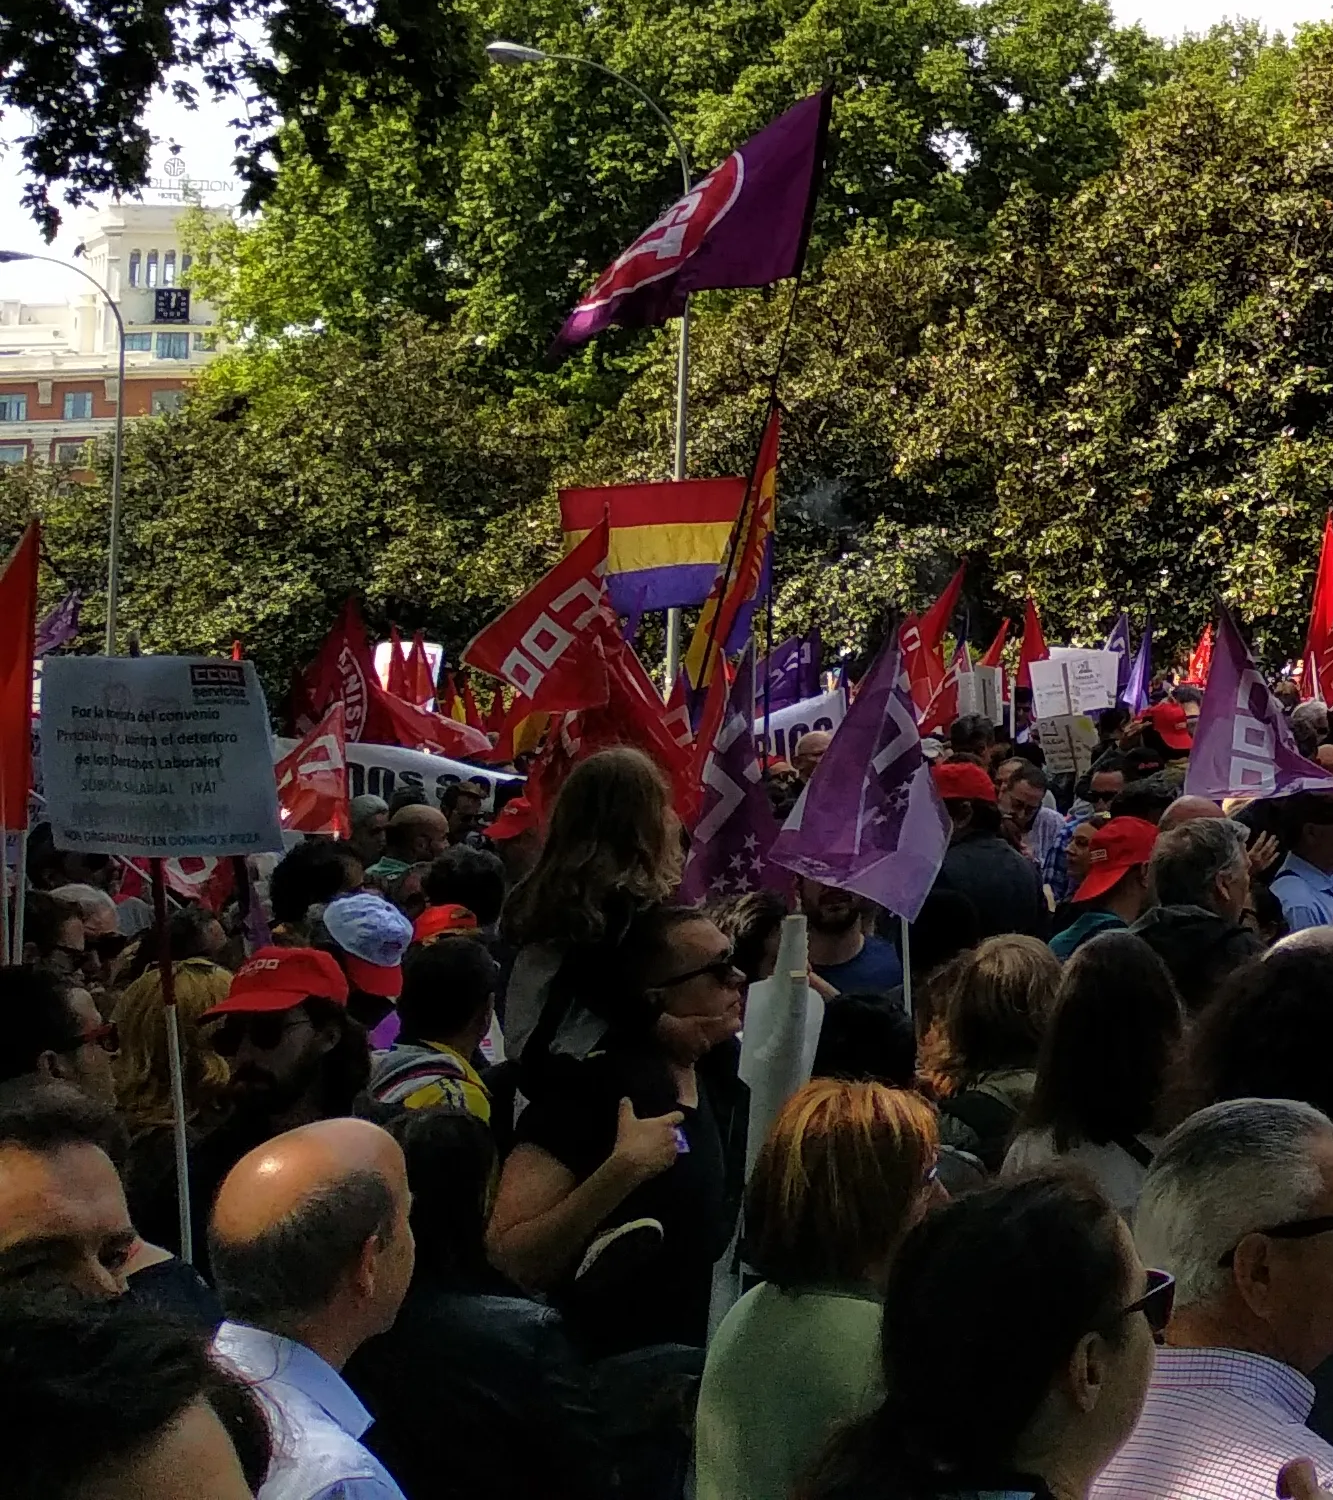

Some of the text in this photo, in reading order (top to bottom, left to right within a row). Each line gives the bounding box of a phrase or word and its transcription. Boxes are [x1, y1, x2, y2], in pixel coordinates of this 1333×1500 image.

[72, 705, 91, 718] Por
[137, 707, 155, 722] del
[159, 708, 220, 722] convenio
[162, 732, 173, 744] el
[178, 731, 238, 744] deterioro
[75, 754, 90, 766] de
